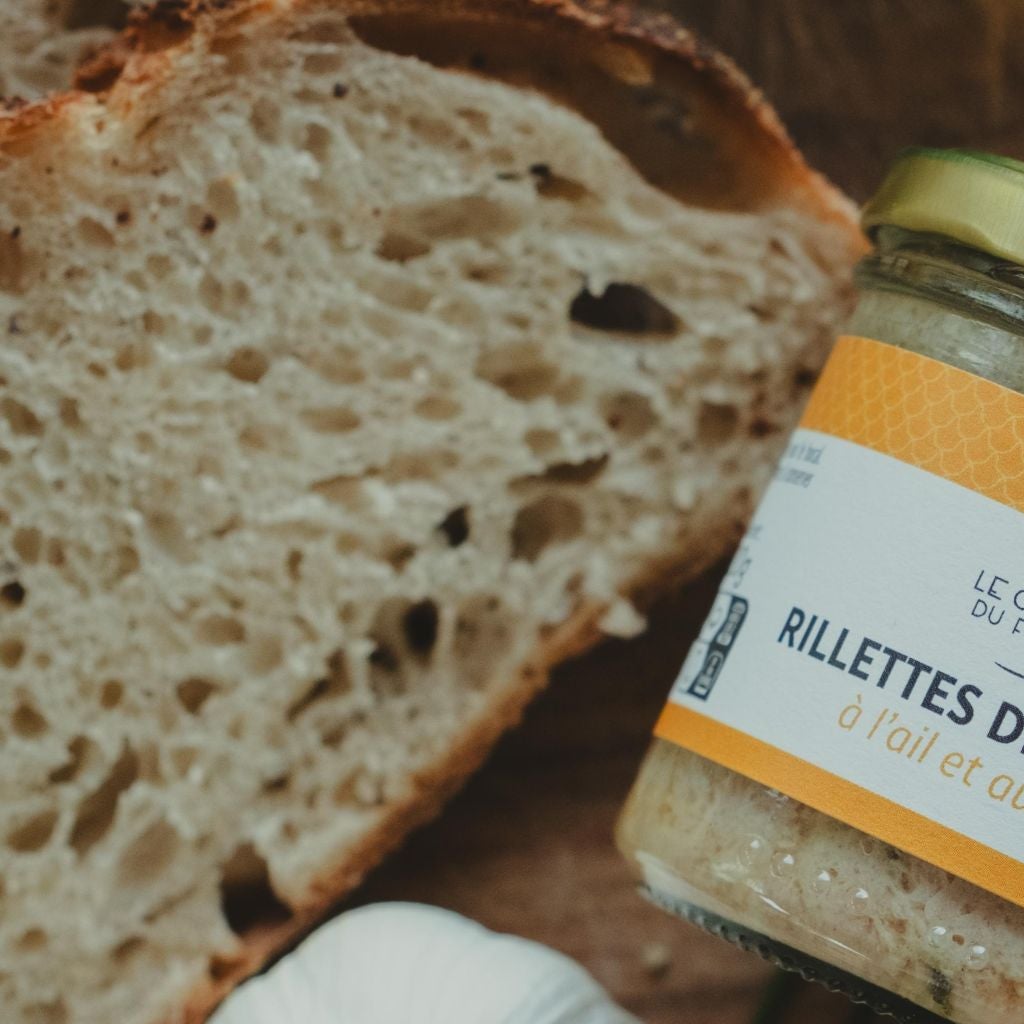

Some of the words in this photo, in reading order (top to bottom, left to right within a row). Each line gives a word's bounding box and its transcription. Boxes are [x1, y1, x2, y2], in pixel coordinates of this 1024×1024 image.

[971, 599, 1005, 625] DU
[974, 570, 1009, 600] LE
[777, 606, 983, 726] RILLETTES
[838, 694, 863, 731] à
[866, 708, 940, 763] l’ail
[939, 752, 984, 787] et
